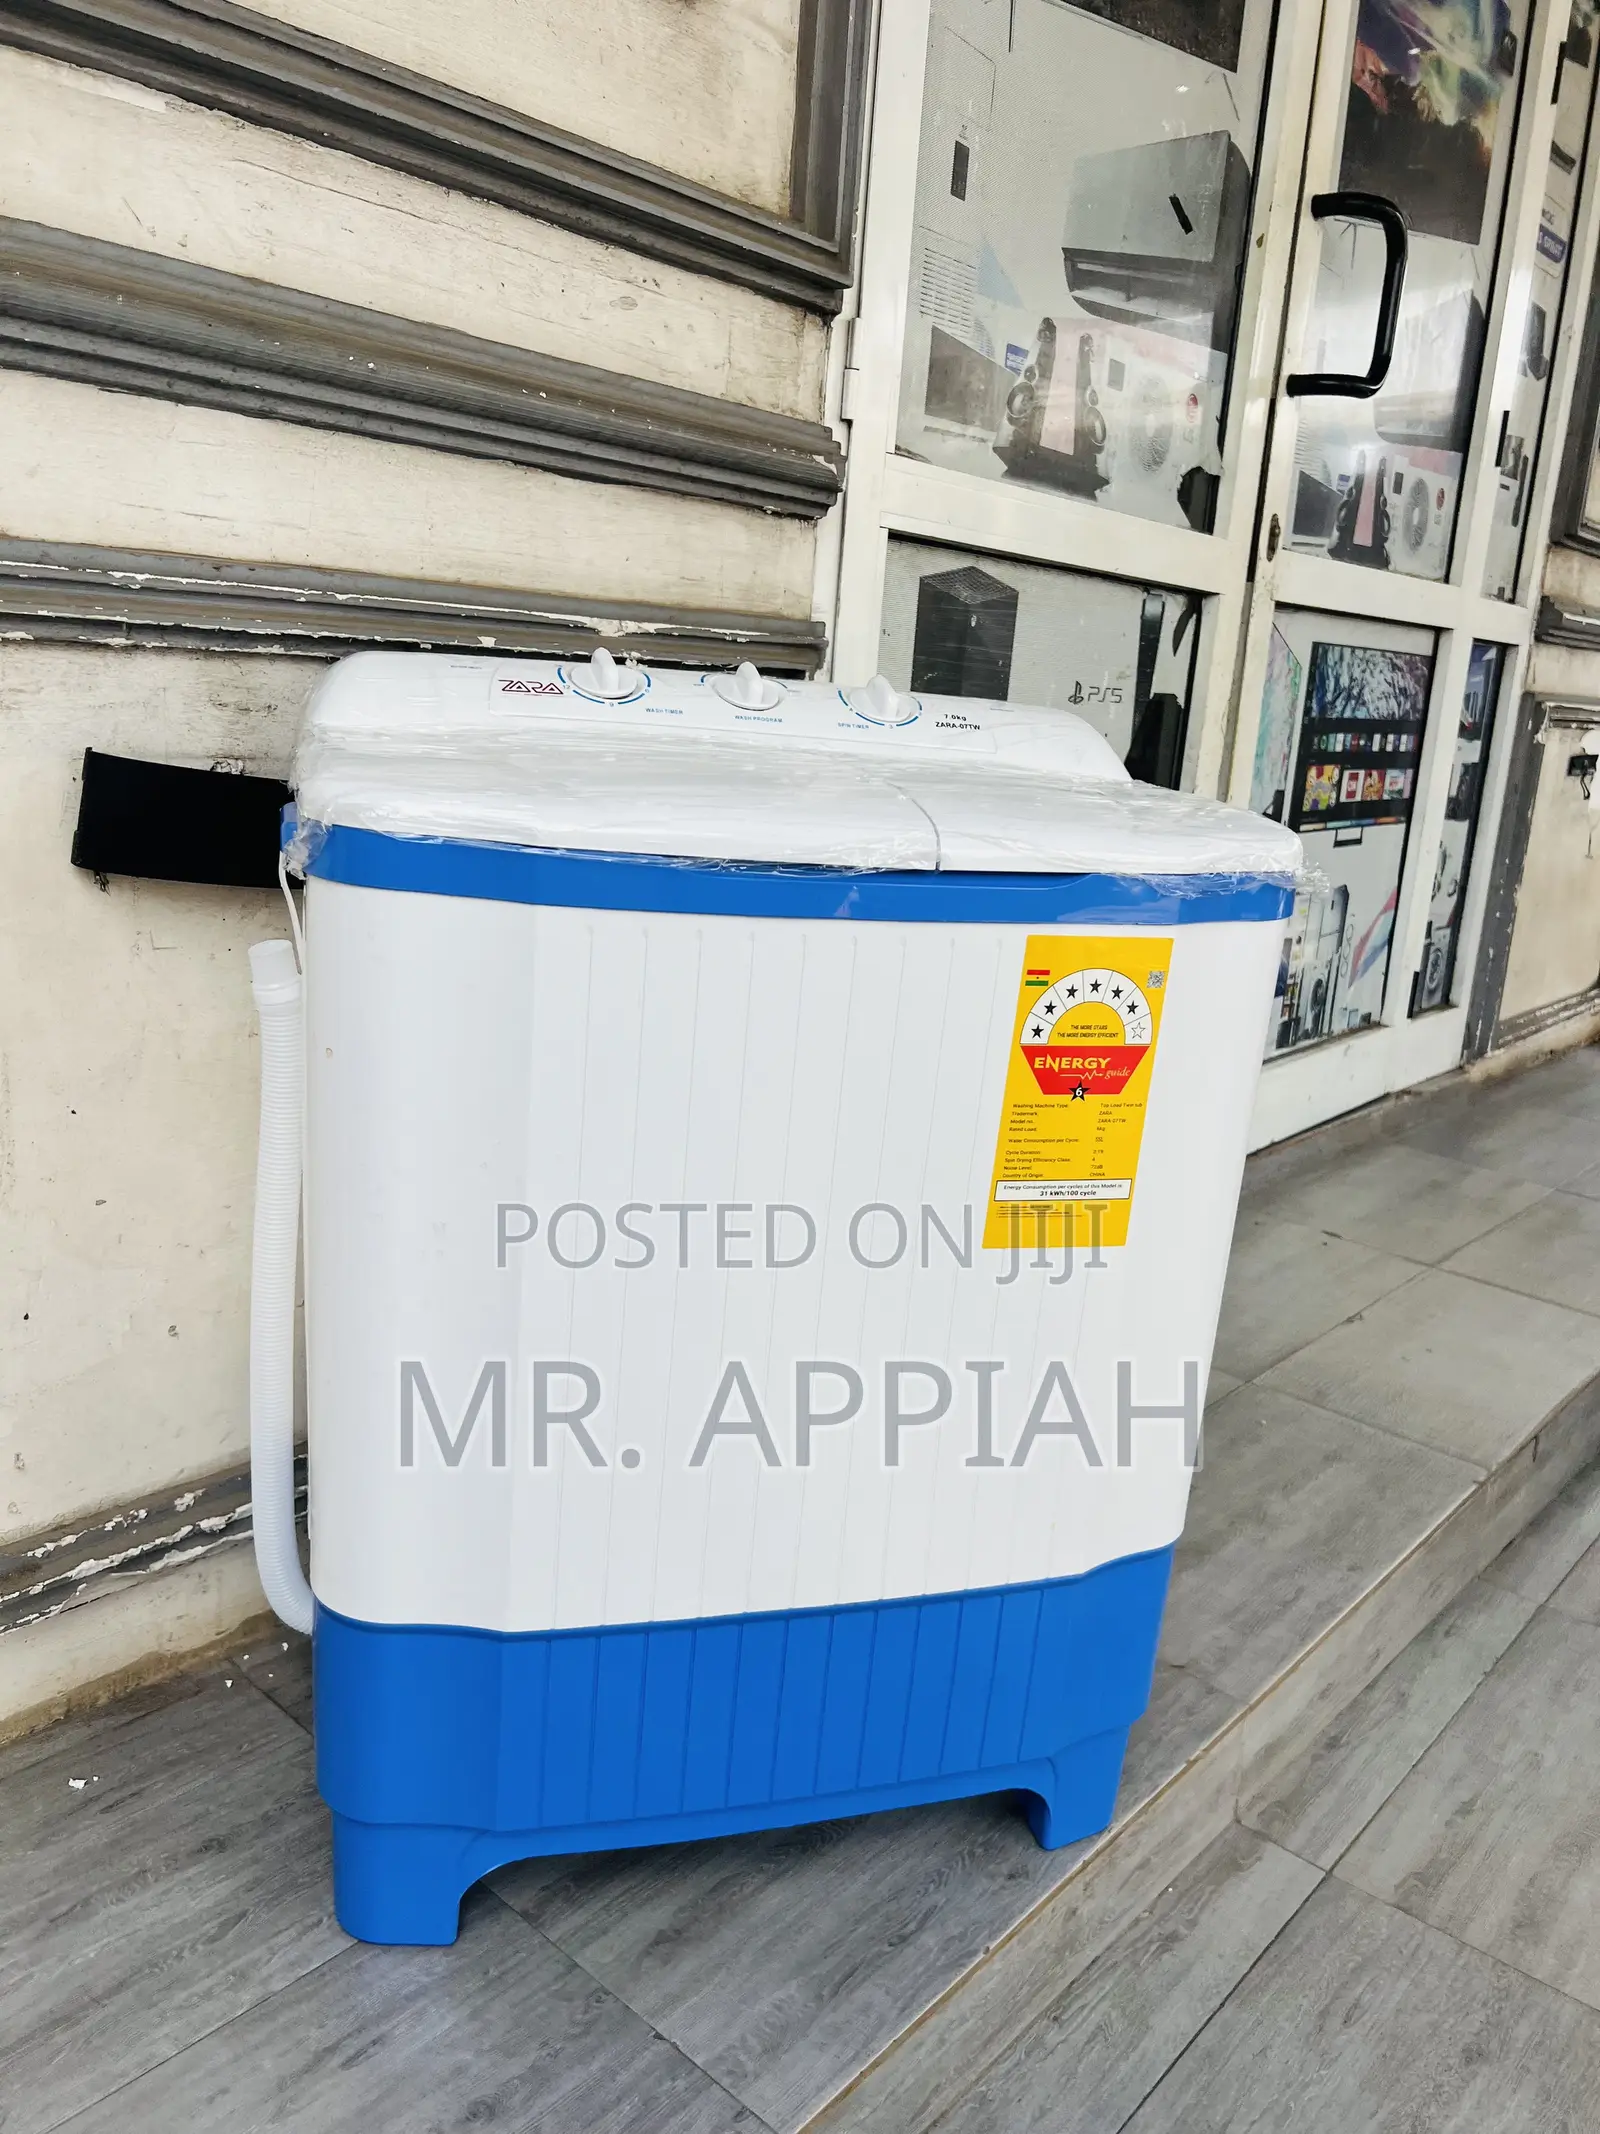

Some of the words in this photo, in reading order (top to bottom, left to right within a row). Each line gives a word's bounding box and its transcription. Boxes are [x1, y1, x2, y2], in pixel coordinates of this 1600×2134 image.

[498, 679, 564, 695] ZARA
[1087, 686, 1123, 703] PS5
[935, 721, 981, 730] ZARA-07TW
[1034, 1053, 1112, 1072] ENERGY
[1104, 1066, 1131, 1080] guide
[1075, 1086, 1083, 1097] 6
